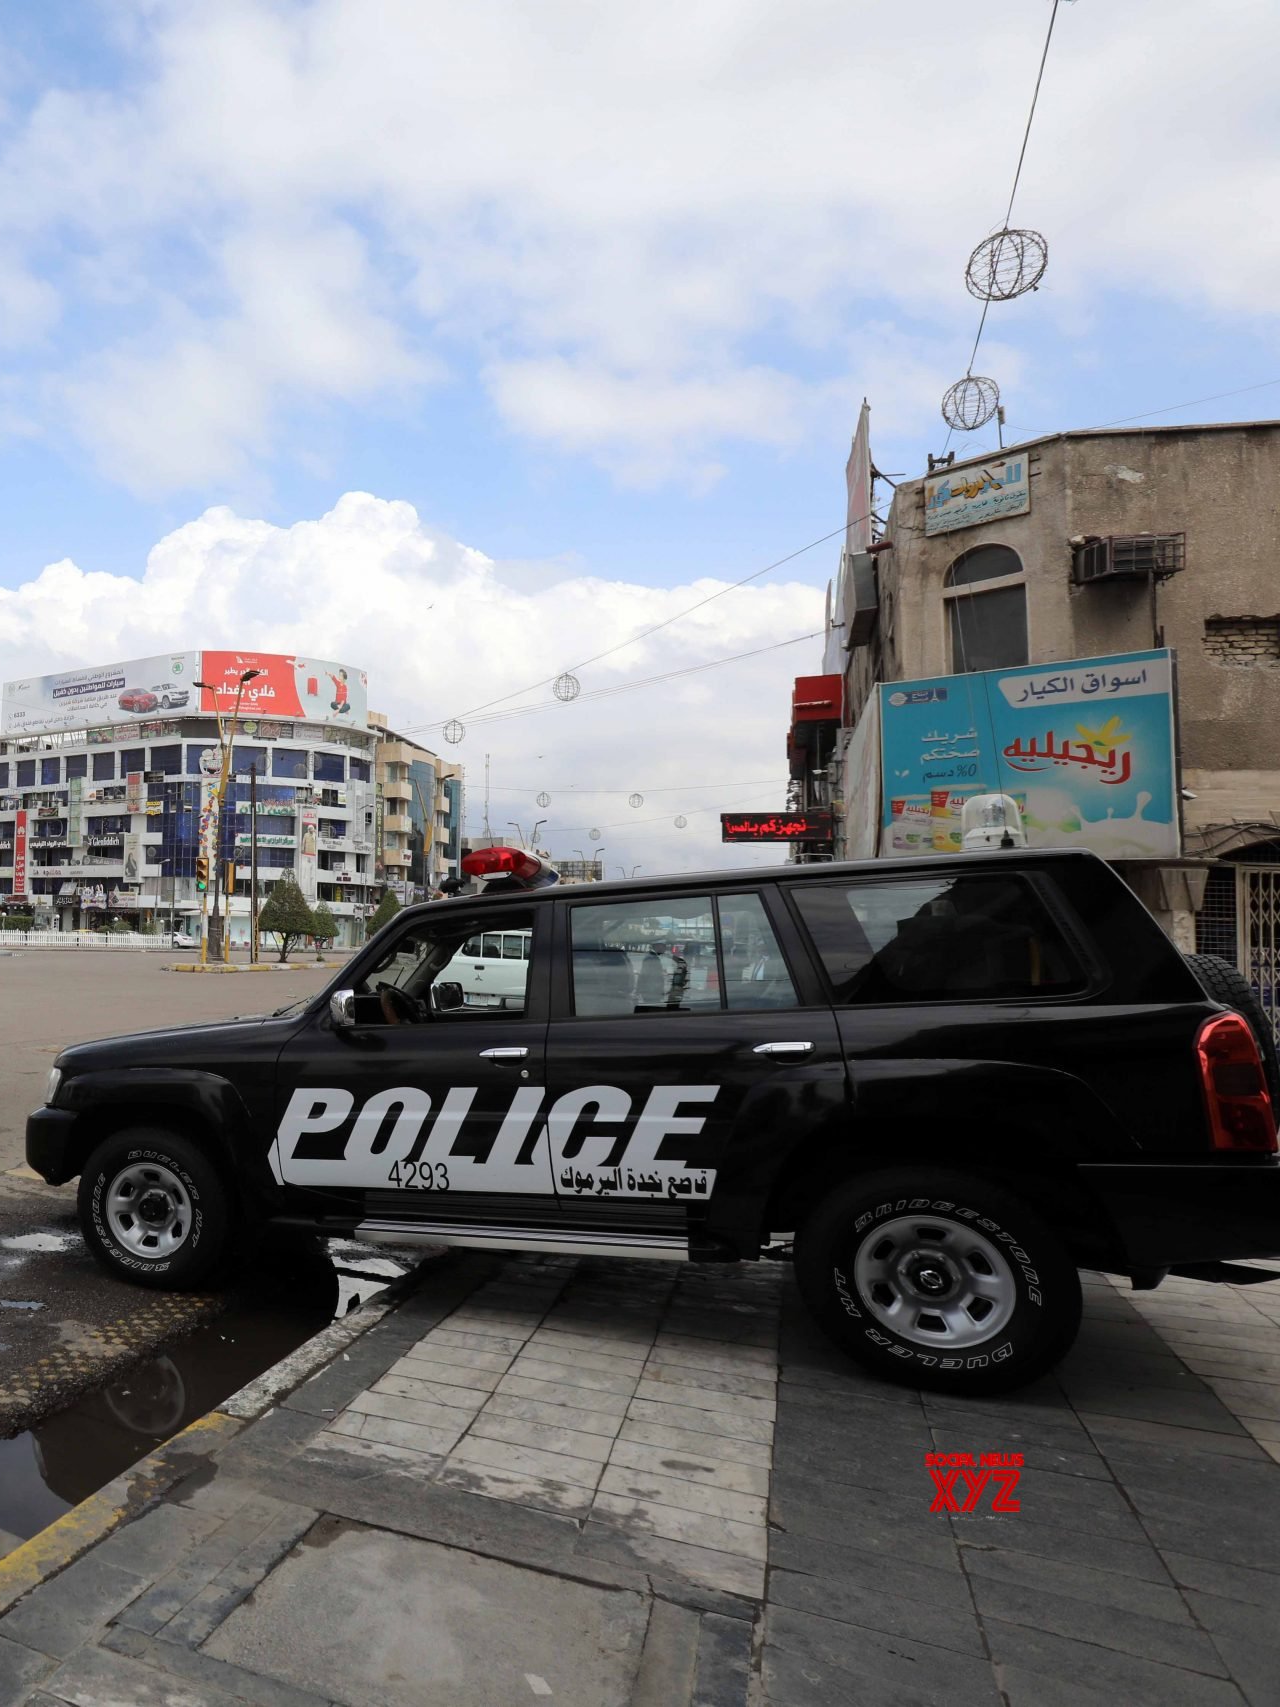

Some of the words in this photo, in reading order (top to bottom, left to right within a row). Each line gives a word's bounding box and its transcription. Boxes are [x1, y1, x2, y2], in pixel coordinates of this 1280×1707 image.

[80, 682, 106, 694] للمواطنين
[106, 679, 125, 689] سيارات
[216, 682, 246, 698] بغداد
[1081, 669, 1147, 694] اسواق
[53, 688, 67, 698] كفيل
[68, 687, 79, 696] بدون
[248, 685, 276, 701] فلاي
[921, 728, 978, 745] شريك
[922, 769, 954, 784] دسم
[92, 835, 120, 847] Glenfiddich
[277, 1085, 721, 1167] POLICE
[387, 1161, 450, 1192] 4293
[560, 1165, 623, 1196] اليرموك
[627, 1168, 663, 1198] نجدة
[92, 1172, 171, 1272] BRIDGESTONE
[854, 1198, 1042, 1306] BRIDGESTONE
[865, 1327, 1014, 1369] DUELER
